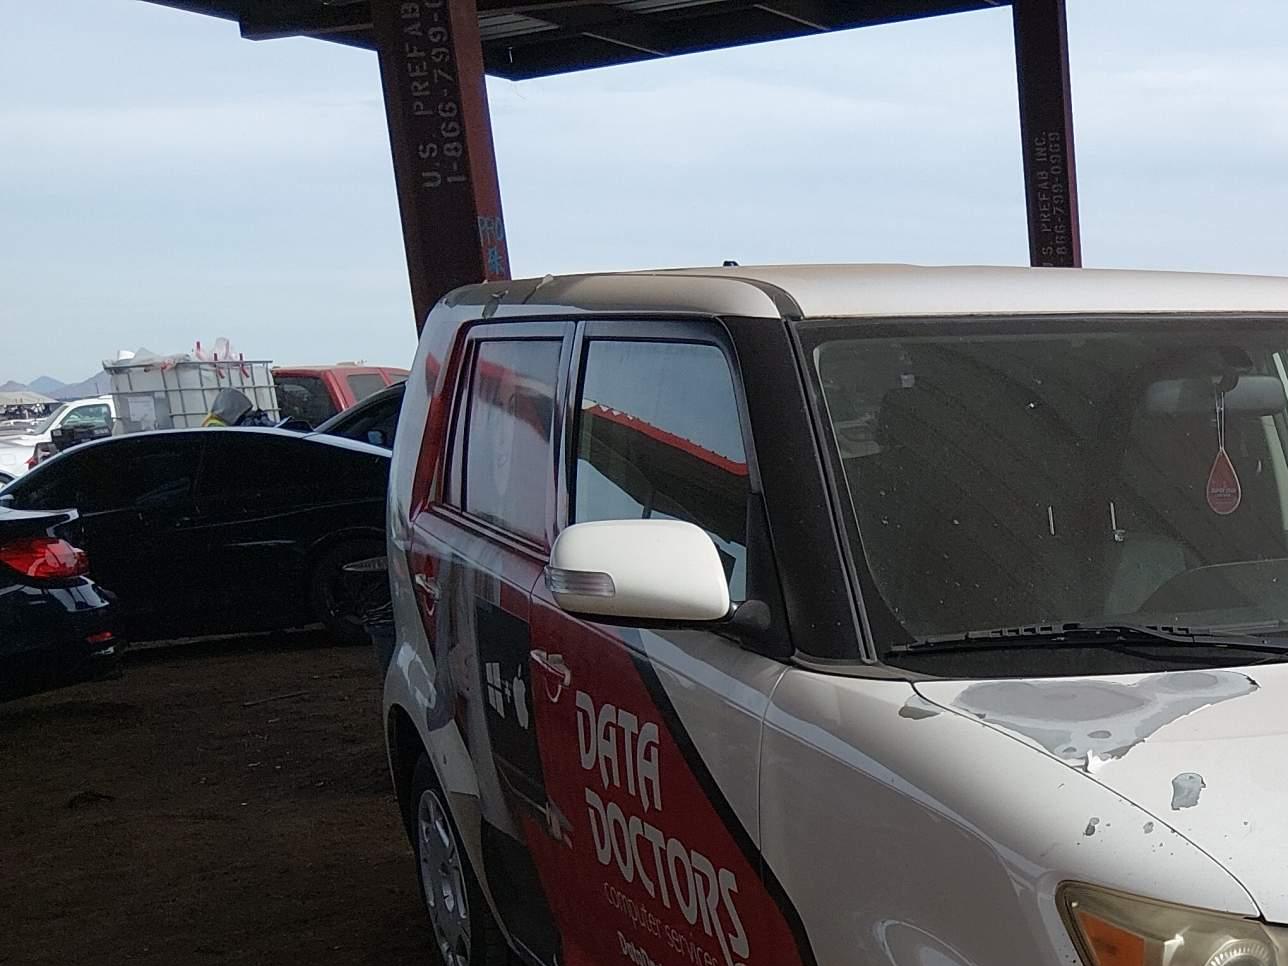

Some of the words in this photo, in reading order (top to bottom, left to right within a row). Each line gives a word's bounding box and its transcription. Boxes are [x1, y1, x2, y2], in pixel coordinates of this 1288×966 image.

[401, 2, 433, 116] PREFAB
[576, 690, 662, 813] DATA
[604, 882, 662, 938] computer
